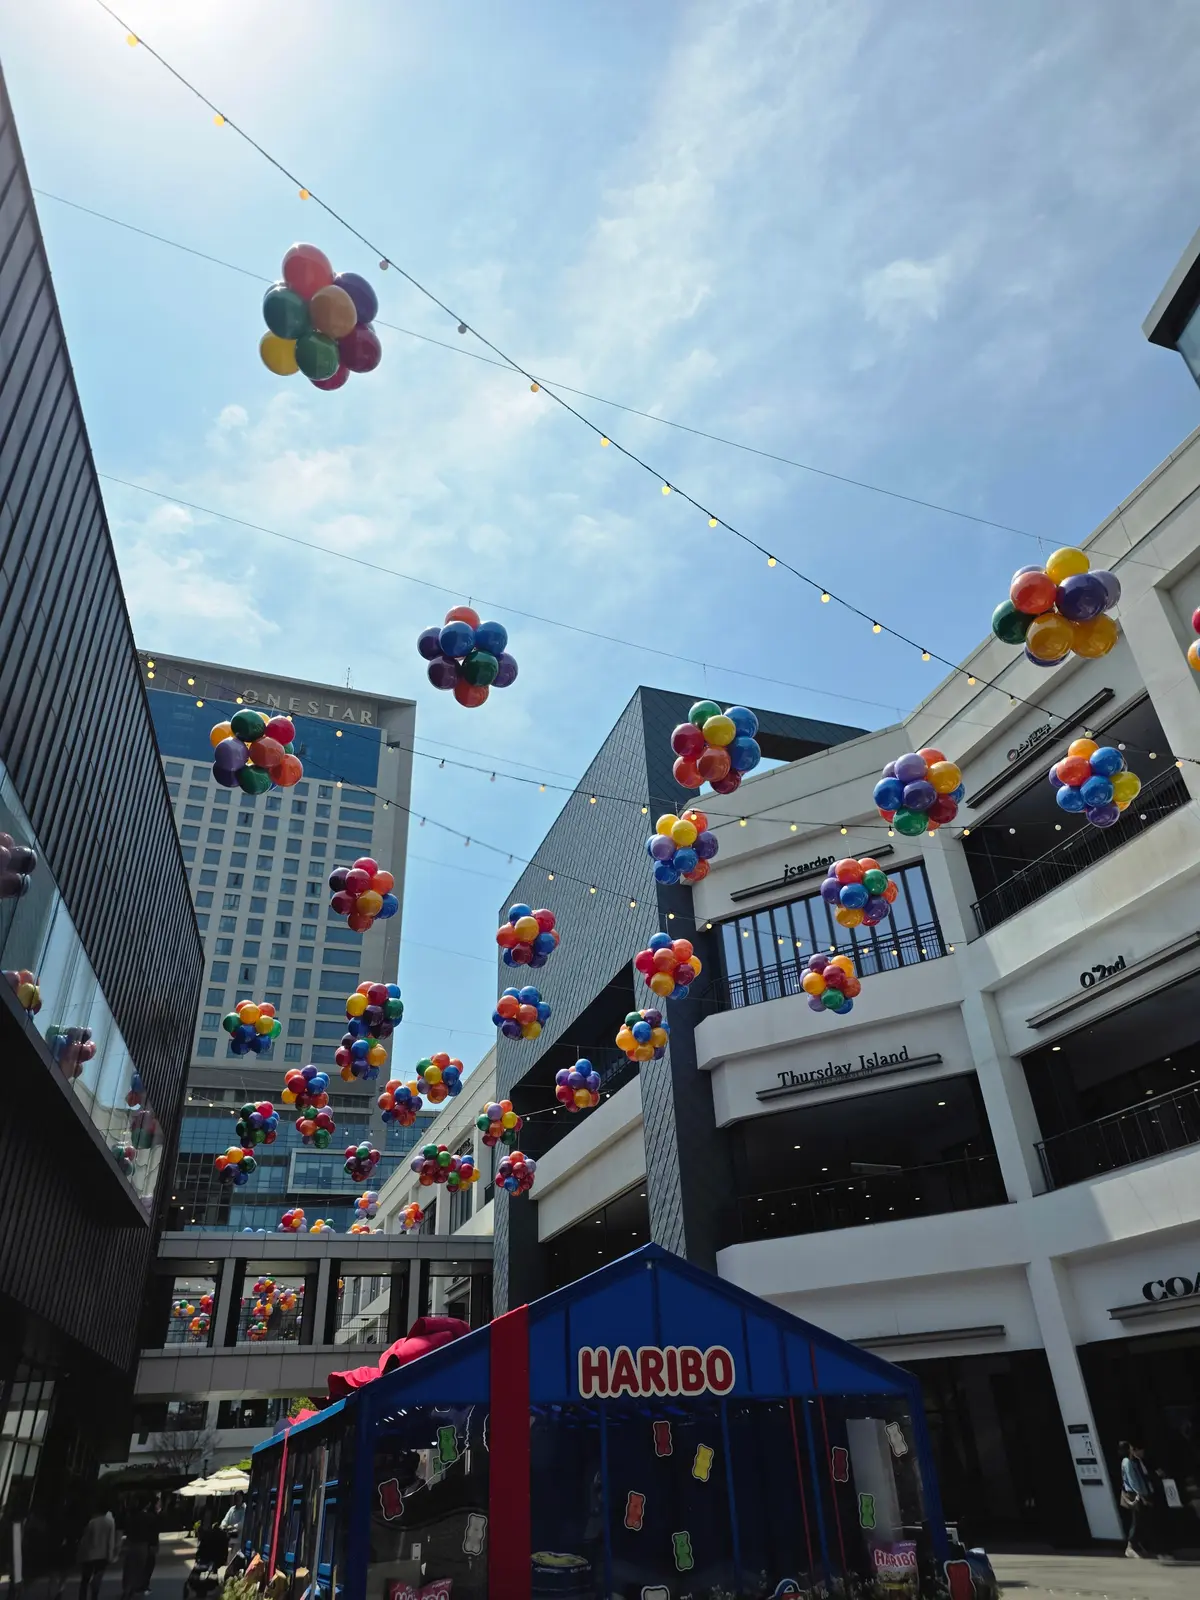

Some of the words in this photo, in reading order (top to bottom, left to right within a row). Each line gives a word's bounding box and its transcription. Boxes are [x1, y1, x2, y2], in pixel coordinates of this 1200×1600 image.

[242, 689, 373, 725] ONESTAR
[777, 1061, 852, 1087] Thursday
[858, 1045, 910, 1070] Island
[1142, 1272, 1200, 1301] CO
[580, 1346, 735, 1398] HARIBO
[874, 1549, 916, 1568] HARIBO
